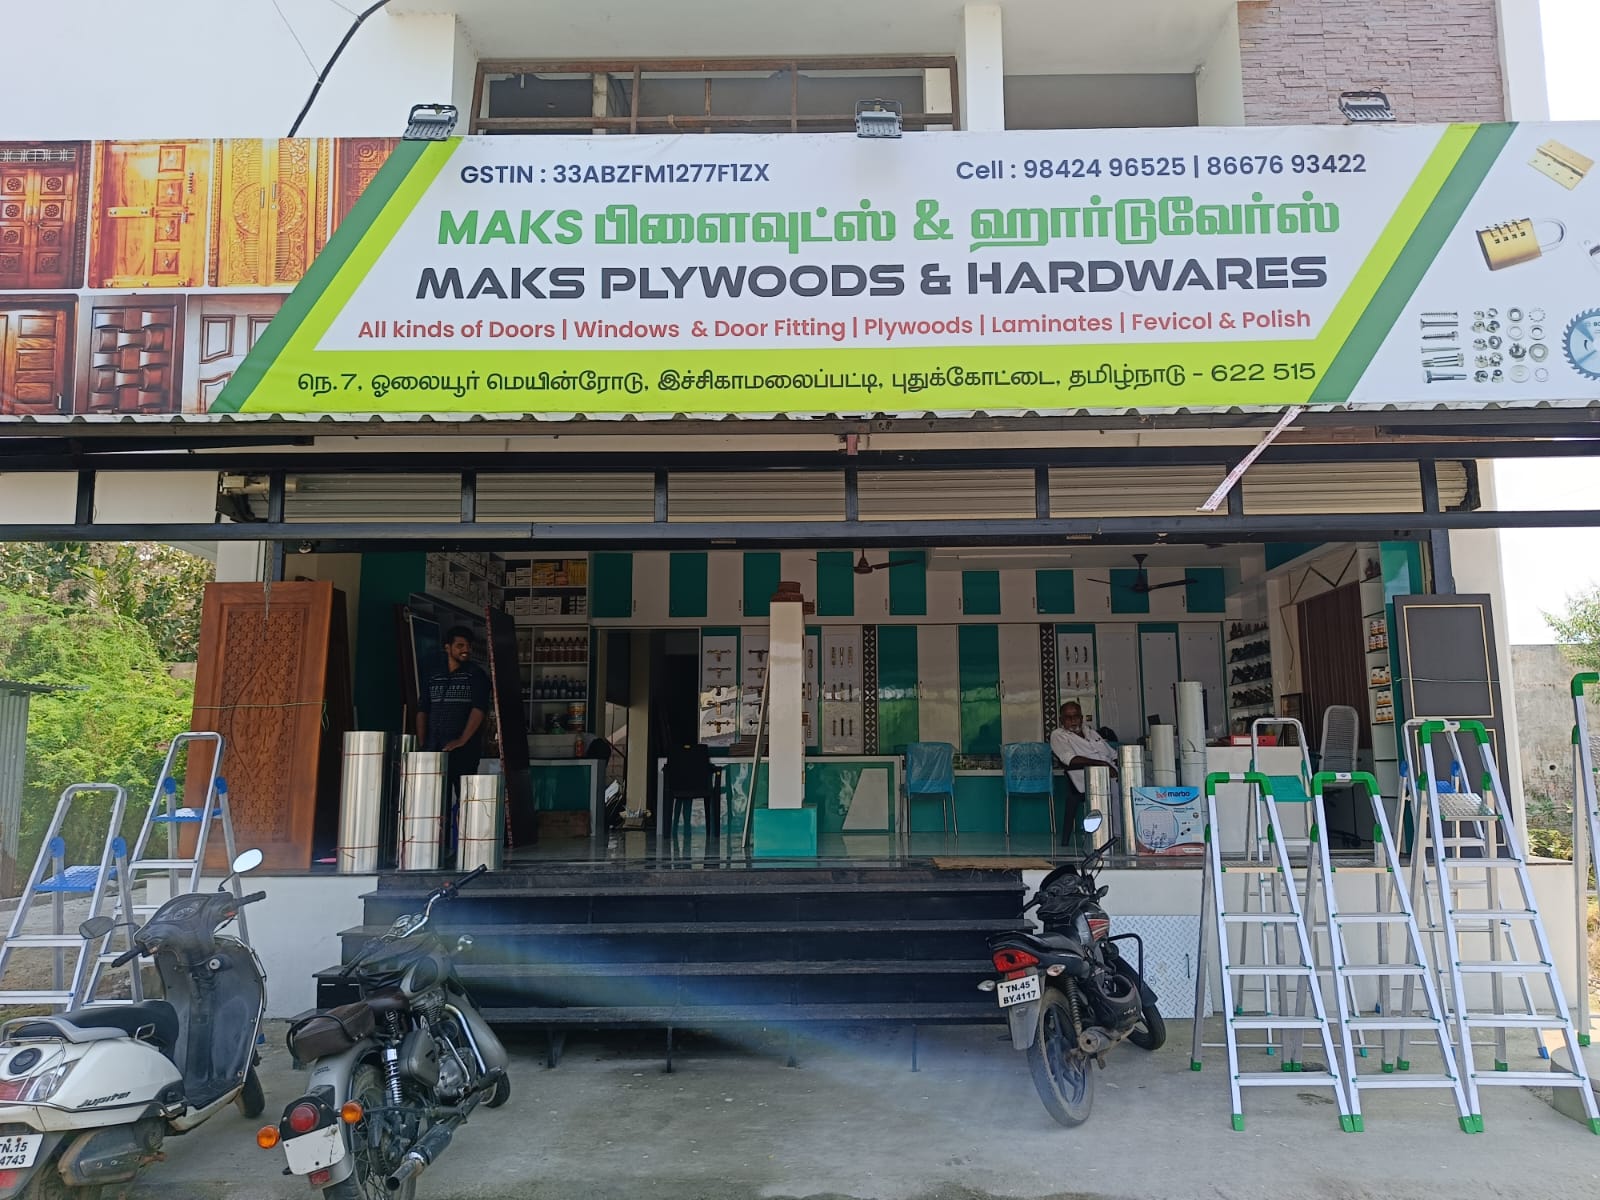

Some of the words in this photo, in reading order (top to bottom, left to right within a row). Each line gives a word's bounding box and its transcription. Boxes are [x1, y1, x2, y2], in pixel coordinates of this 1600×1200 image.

[460, 164, 534, 184] GSTIN
[552, 163, 770, 184] 33ABZFM1277F1ZX
[955, 159, 1004, 180] Cell
[1023, 158, 1103, 179] 98424
[1108, 156, 1186, 177] 96525
[1207, 154, 1284, 176] 86676
[1290, 153, 1367, 174] 93422
[437, 209, 583, 245] MAKS
[594, 198, 897, 255] பிளைவுட்ஸ்
[913, 199, 954, 241] &
[969, 190, 1340, 253] ஹார்டுவேர்ஸ்
[415, 266, 586, 300] MAKS
[600, 263, 905, 300] PLYWOODS
[919, 262, 952, 296] &
[967, 255, 1328, 295] HARDWARES
[357, 320, 387, 339] All
[392, 319, 455, 339] kinds
[460, 319, 484, 338] of
[488, 320, 556, 338] Doors
[573, 319, 680, 339] Windows
[691, 320, 709, 338] &
[714, 320, 769, 337] Door
[774, 317, 846, 342] Fitting
[864, 315, 973, 342] Plywoods
[991, 313, 1113, 333] Laminates
[1131, 310, 1213, 331] Fevicol
[1218, 311, 1237, 329] &
[1241, 308, 1312, 329] Polish
[892, 365, 1061, 394] புதுக்கோட்டை,
[1067, 362, 1186, 392] தமிழ்நாடு
[1210, 363, 1266, 382] 622
[1272, 362, 1317, 381] 515
[1003, 990, 1036, 1005] BY.4117
[1006, 981, 1031, 993] TN.45
